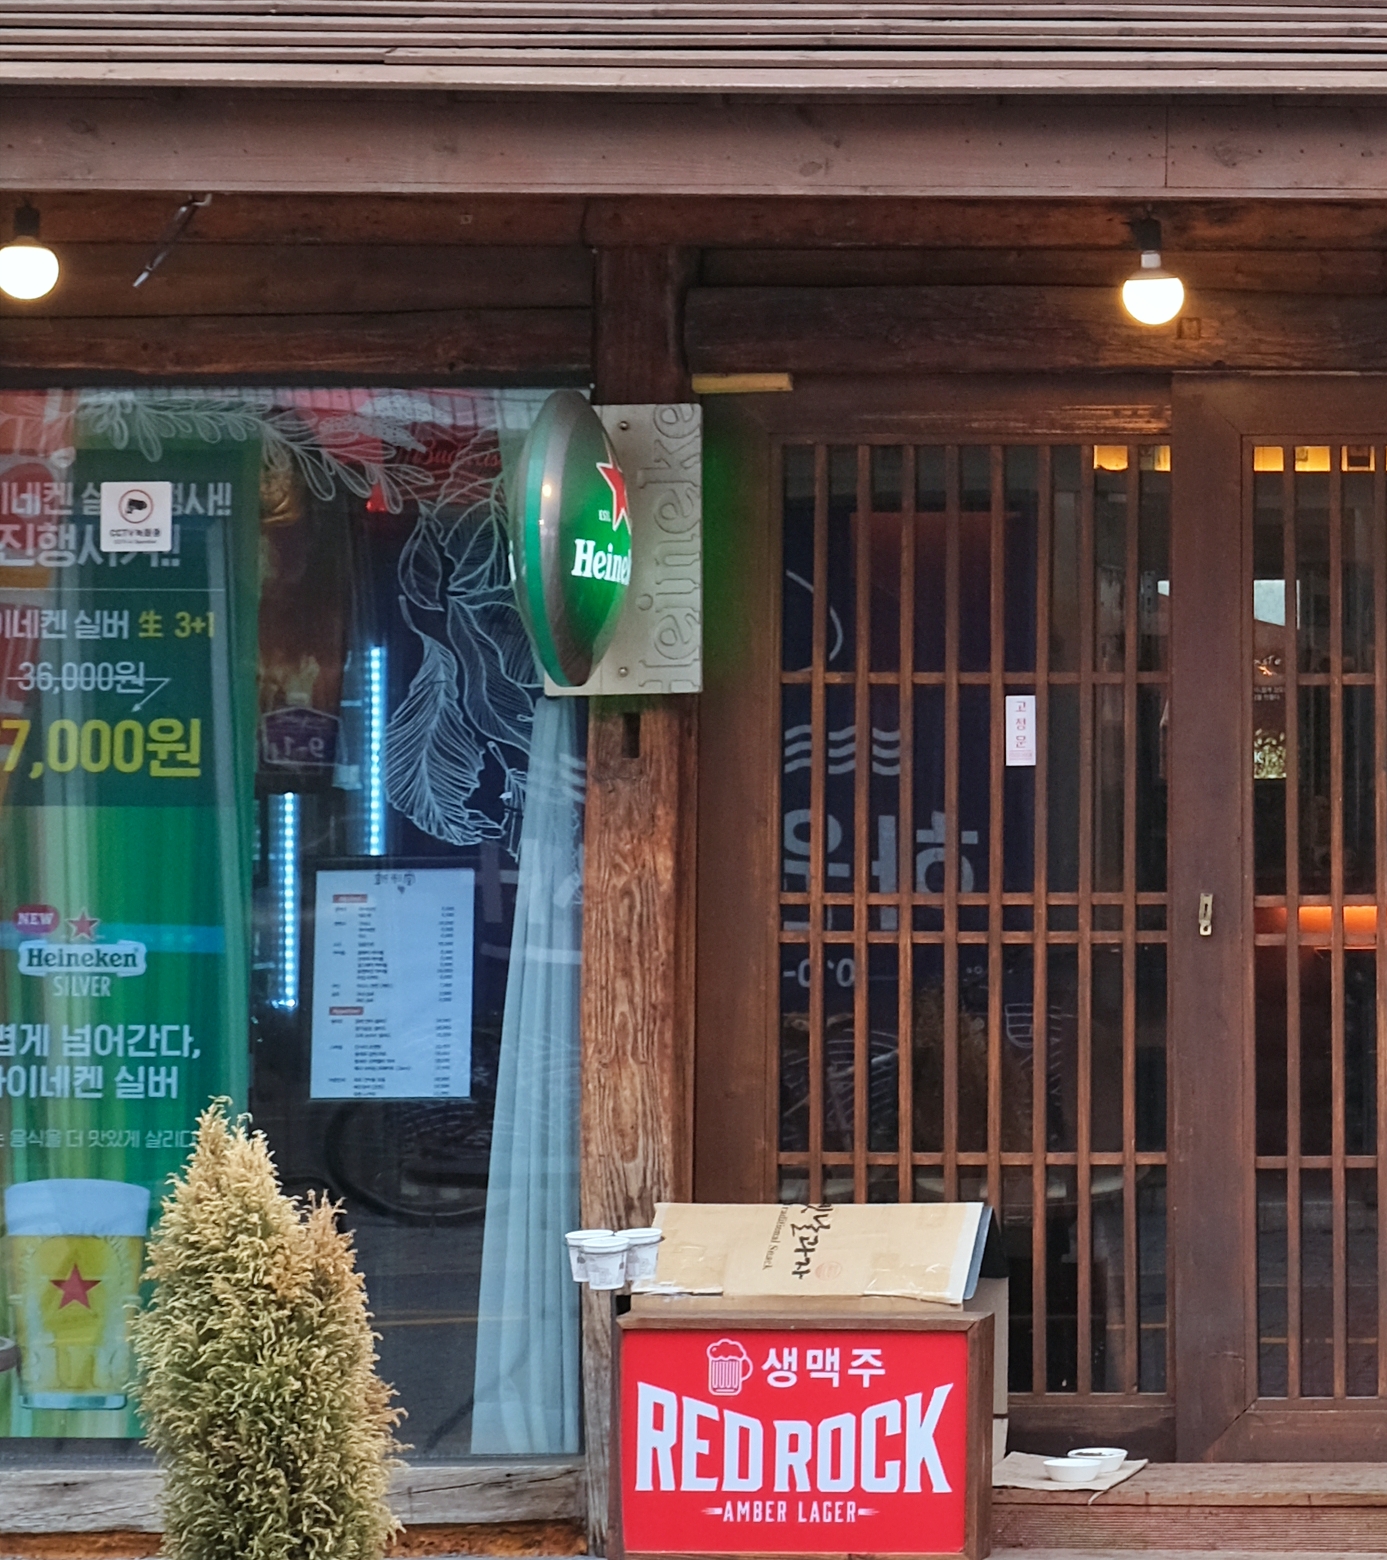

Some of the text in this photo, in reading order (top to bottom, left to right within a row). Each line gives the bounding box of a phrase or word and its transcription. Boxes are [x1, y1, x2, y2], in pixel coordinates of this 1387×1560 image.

[74, 609, 129, 640] 실버
[174, 611, 215, 639] 3+1
[17, 661, 145, 695] 36,000원
[17, 912, 54, 925] NEW
[26, 947, 138, 969] Heineken
[53, 976, 111, 997] SILVER
[62, 1024, 201, 1059] 넘어간다,
[0, 1065, 179, 1100] 이네켄 실버
[10, 1129, 61, 1148] 음식을
[66, 1130, 83, 1148] 더
[88, 1129, 140, 1149] 맛있게
[761, 1346, 886, 1388] 생맥주
[722, 1500, 857, 1523] AMBER LAGER
